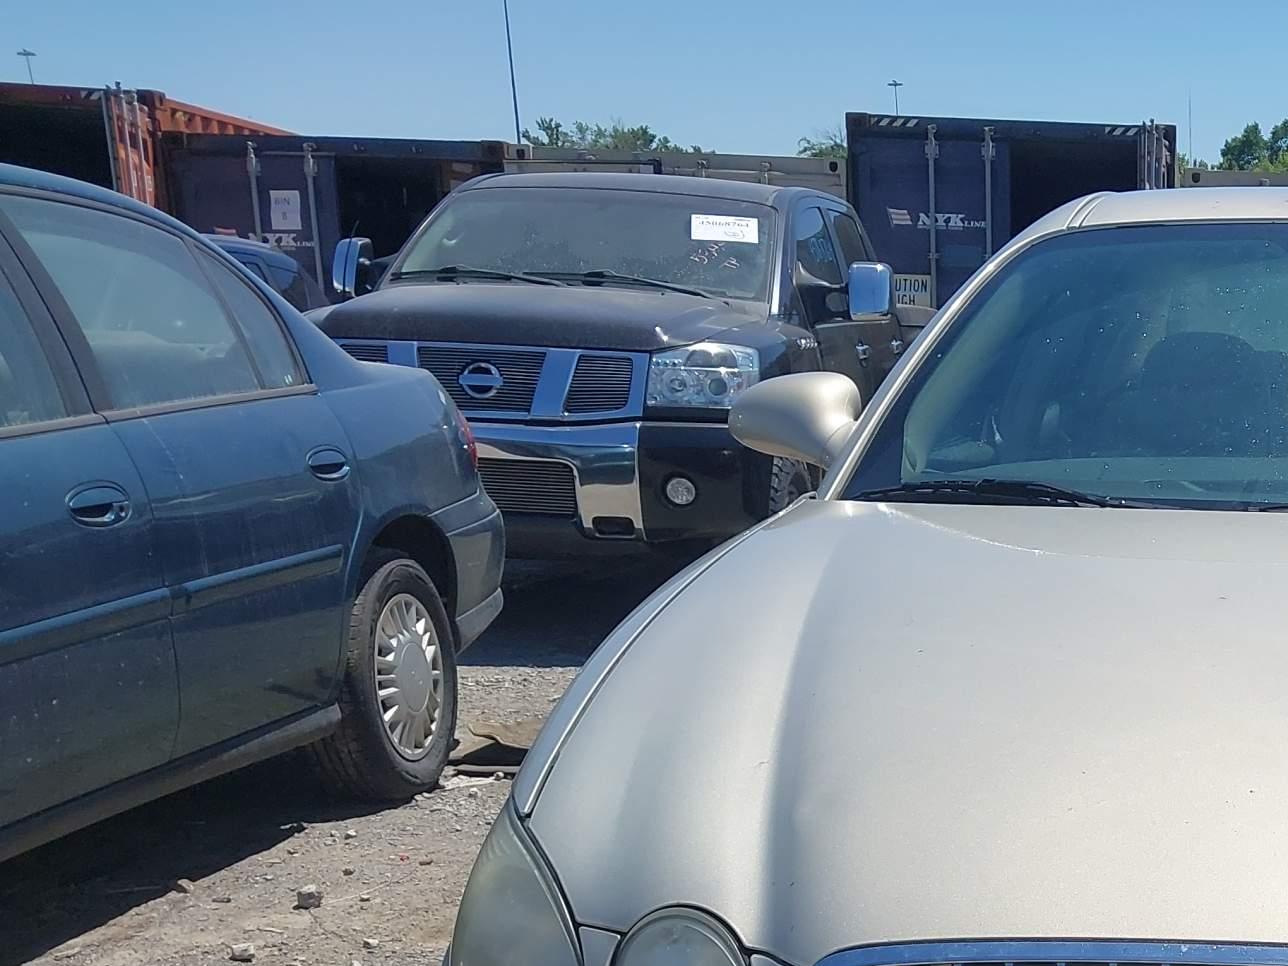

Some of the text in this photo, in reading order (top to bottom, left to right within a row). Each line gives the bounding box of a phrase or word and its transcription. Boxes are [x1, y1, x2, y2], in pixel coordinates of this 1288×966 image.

[917, 213, 965, 226] NYK
[895, 278, 928, 293] UTION
[897, 294, 916, 305] IGH
